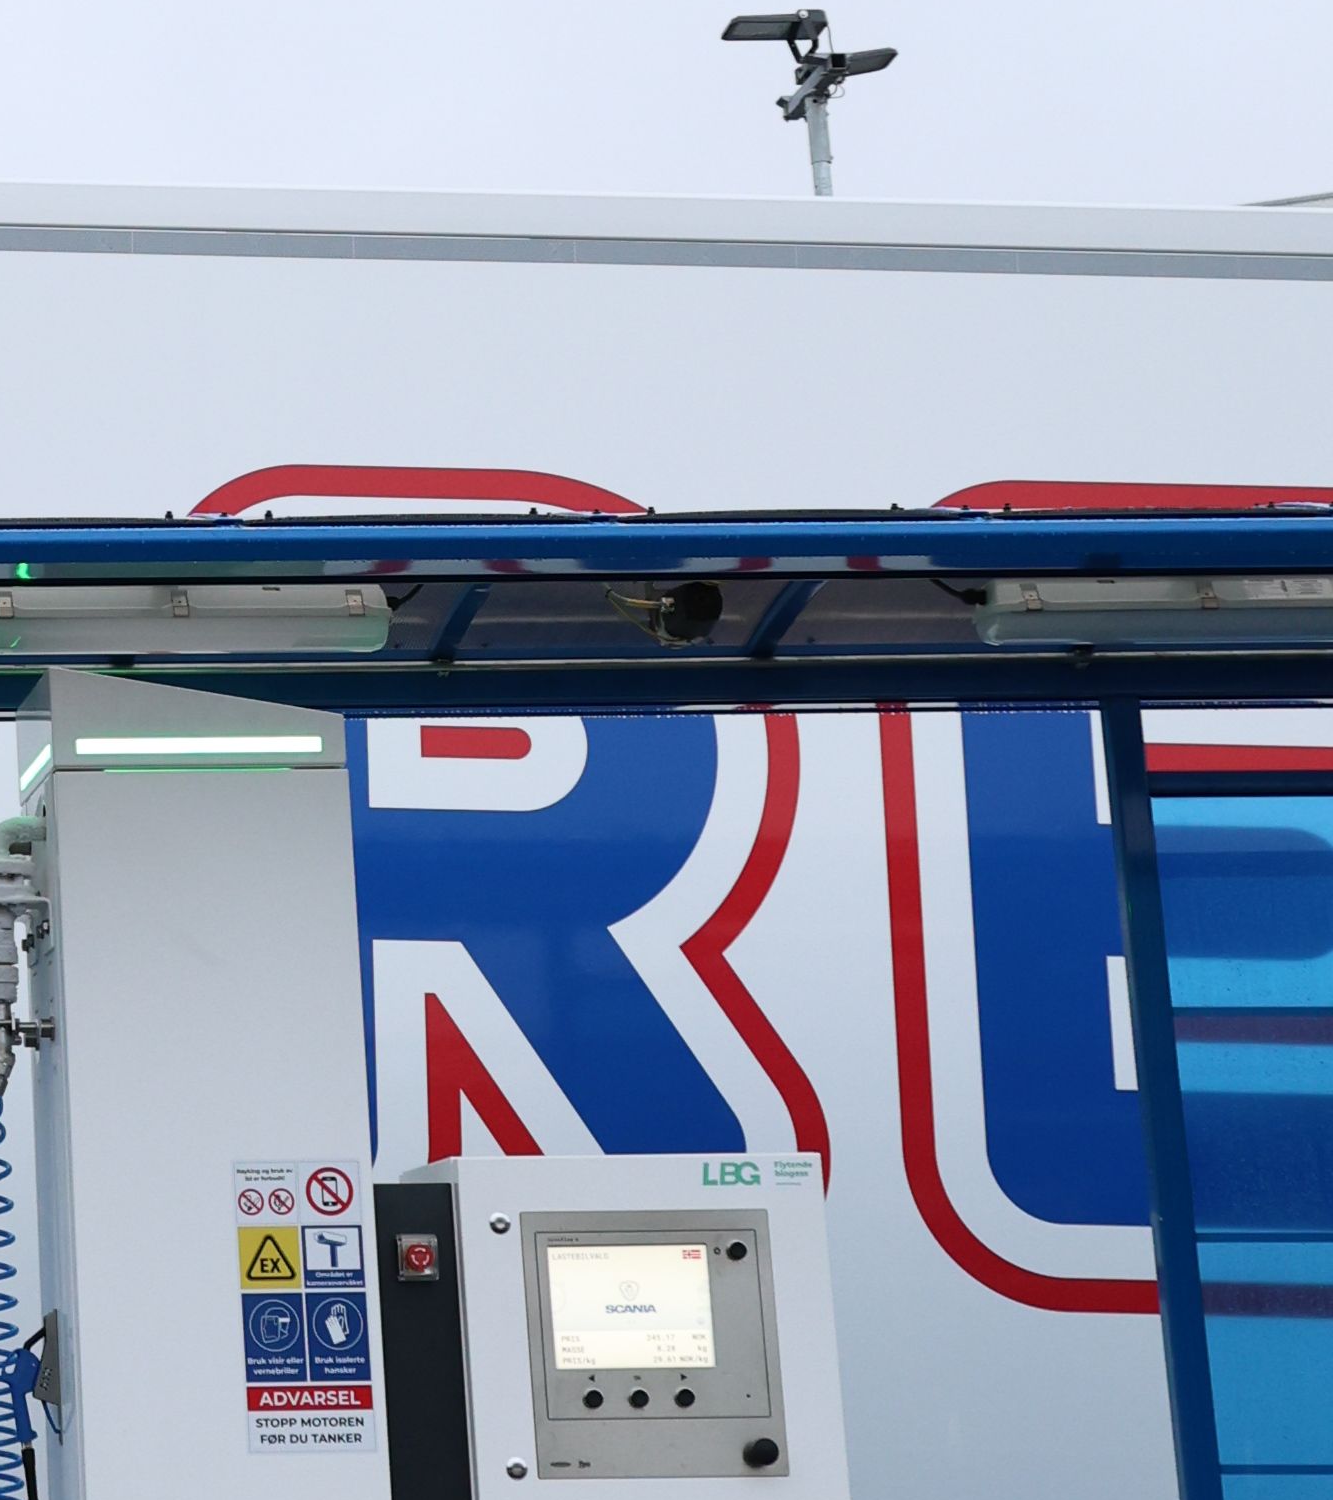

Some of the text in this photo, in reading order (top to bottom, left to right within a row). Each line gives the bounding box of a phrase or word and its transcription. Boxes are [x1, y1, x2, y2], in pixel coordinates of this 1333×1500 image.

[702, 1162, 761, 1186] LBG
[260, 1258, 282, 1273] EX
[605, 1304, 657, 1314] SCANIA
[259, 1390, 361, 1406] ADVARSEL
[255, 1417, 364, 1428] STOPP MOTOREN
[260, 1433, 362, 1444] FØR DU TANKER
